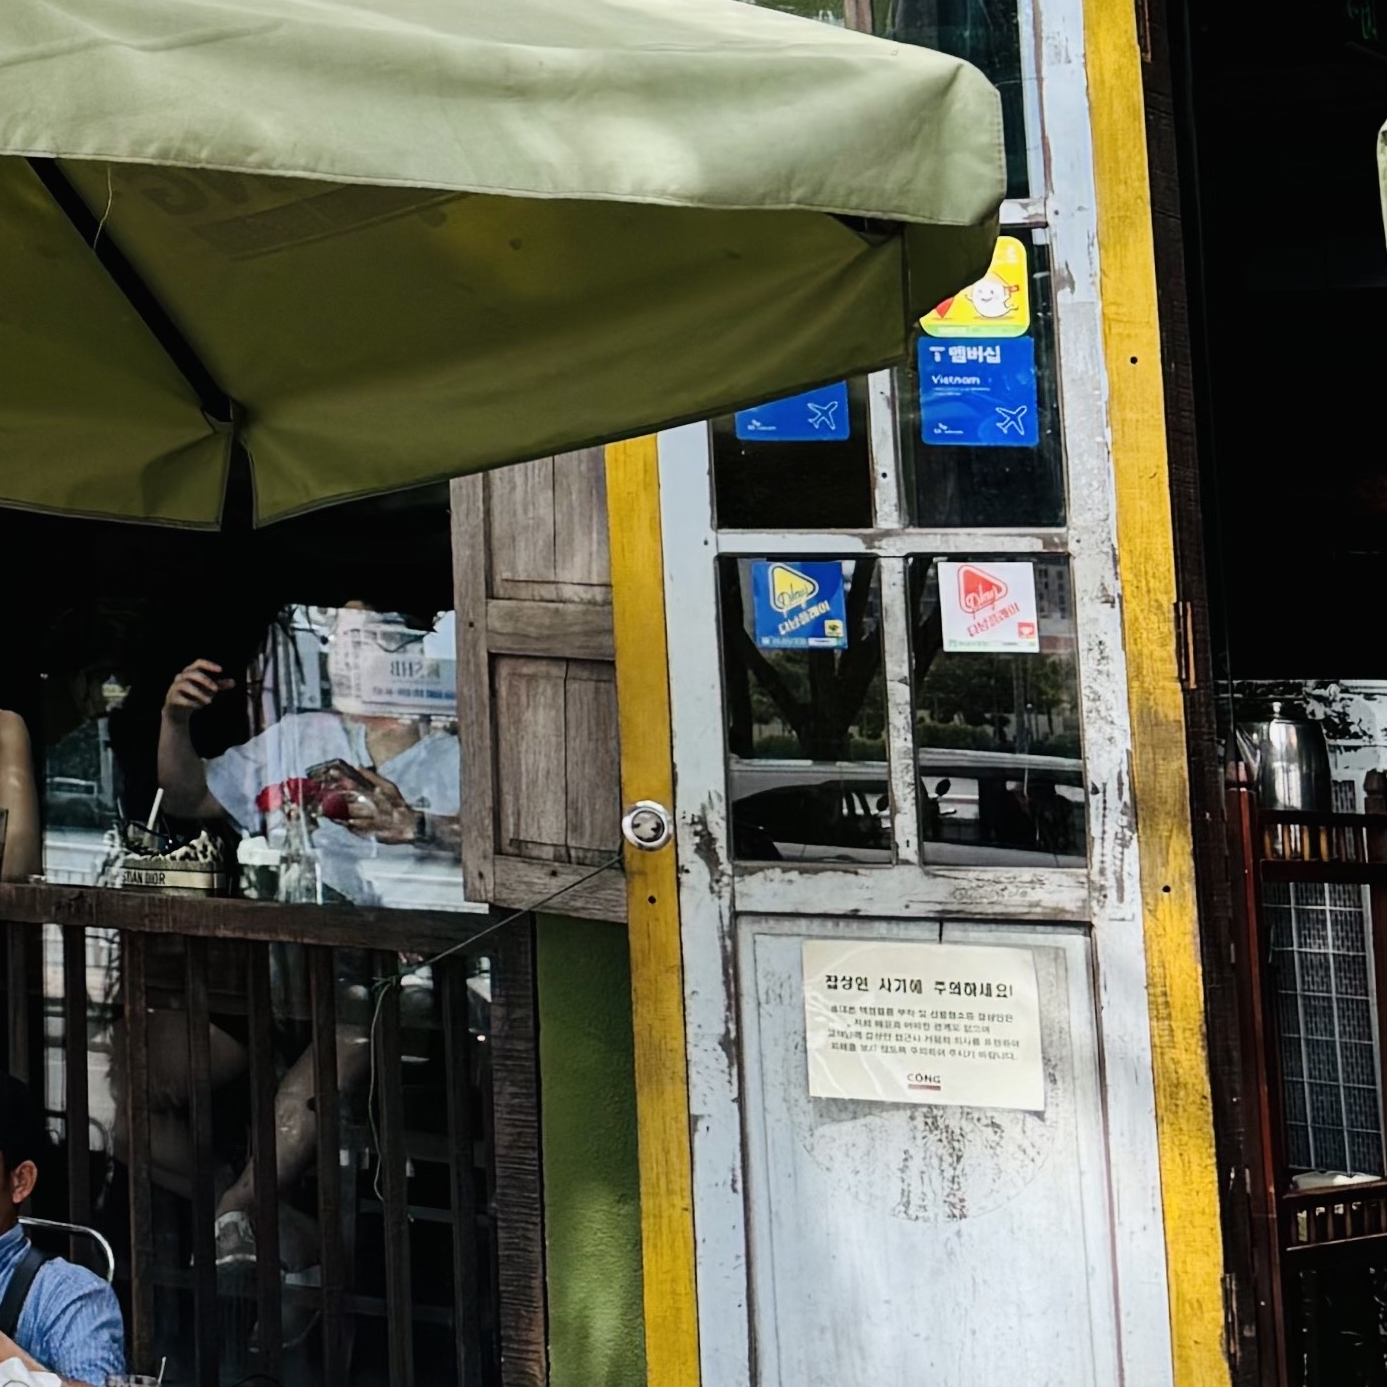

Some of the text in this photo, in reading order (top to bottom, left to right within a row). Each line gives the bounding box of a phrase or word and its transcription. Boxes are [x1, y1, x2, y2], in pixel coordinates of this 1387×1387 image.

[948, 345, 1001, 364] 멤버십
[931, 374, 981, 385] Vietnam
[878, 977, 924, 995] 사기에
[934, 980, 1014, 998] 주의하세요!
